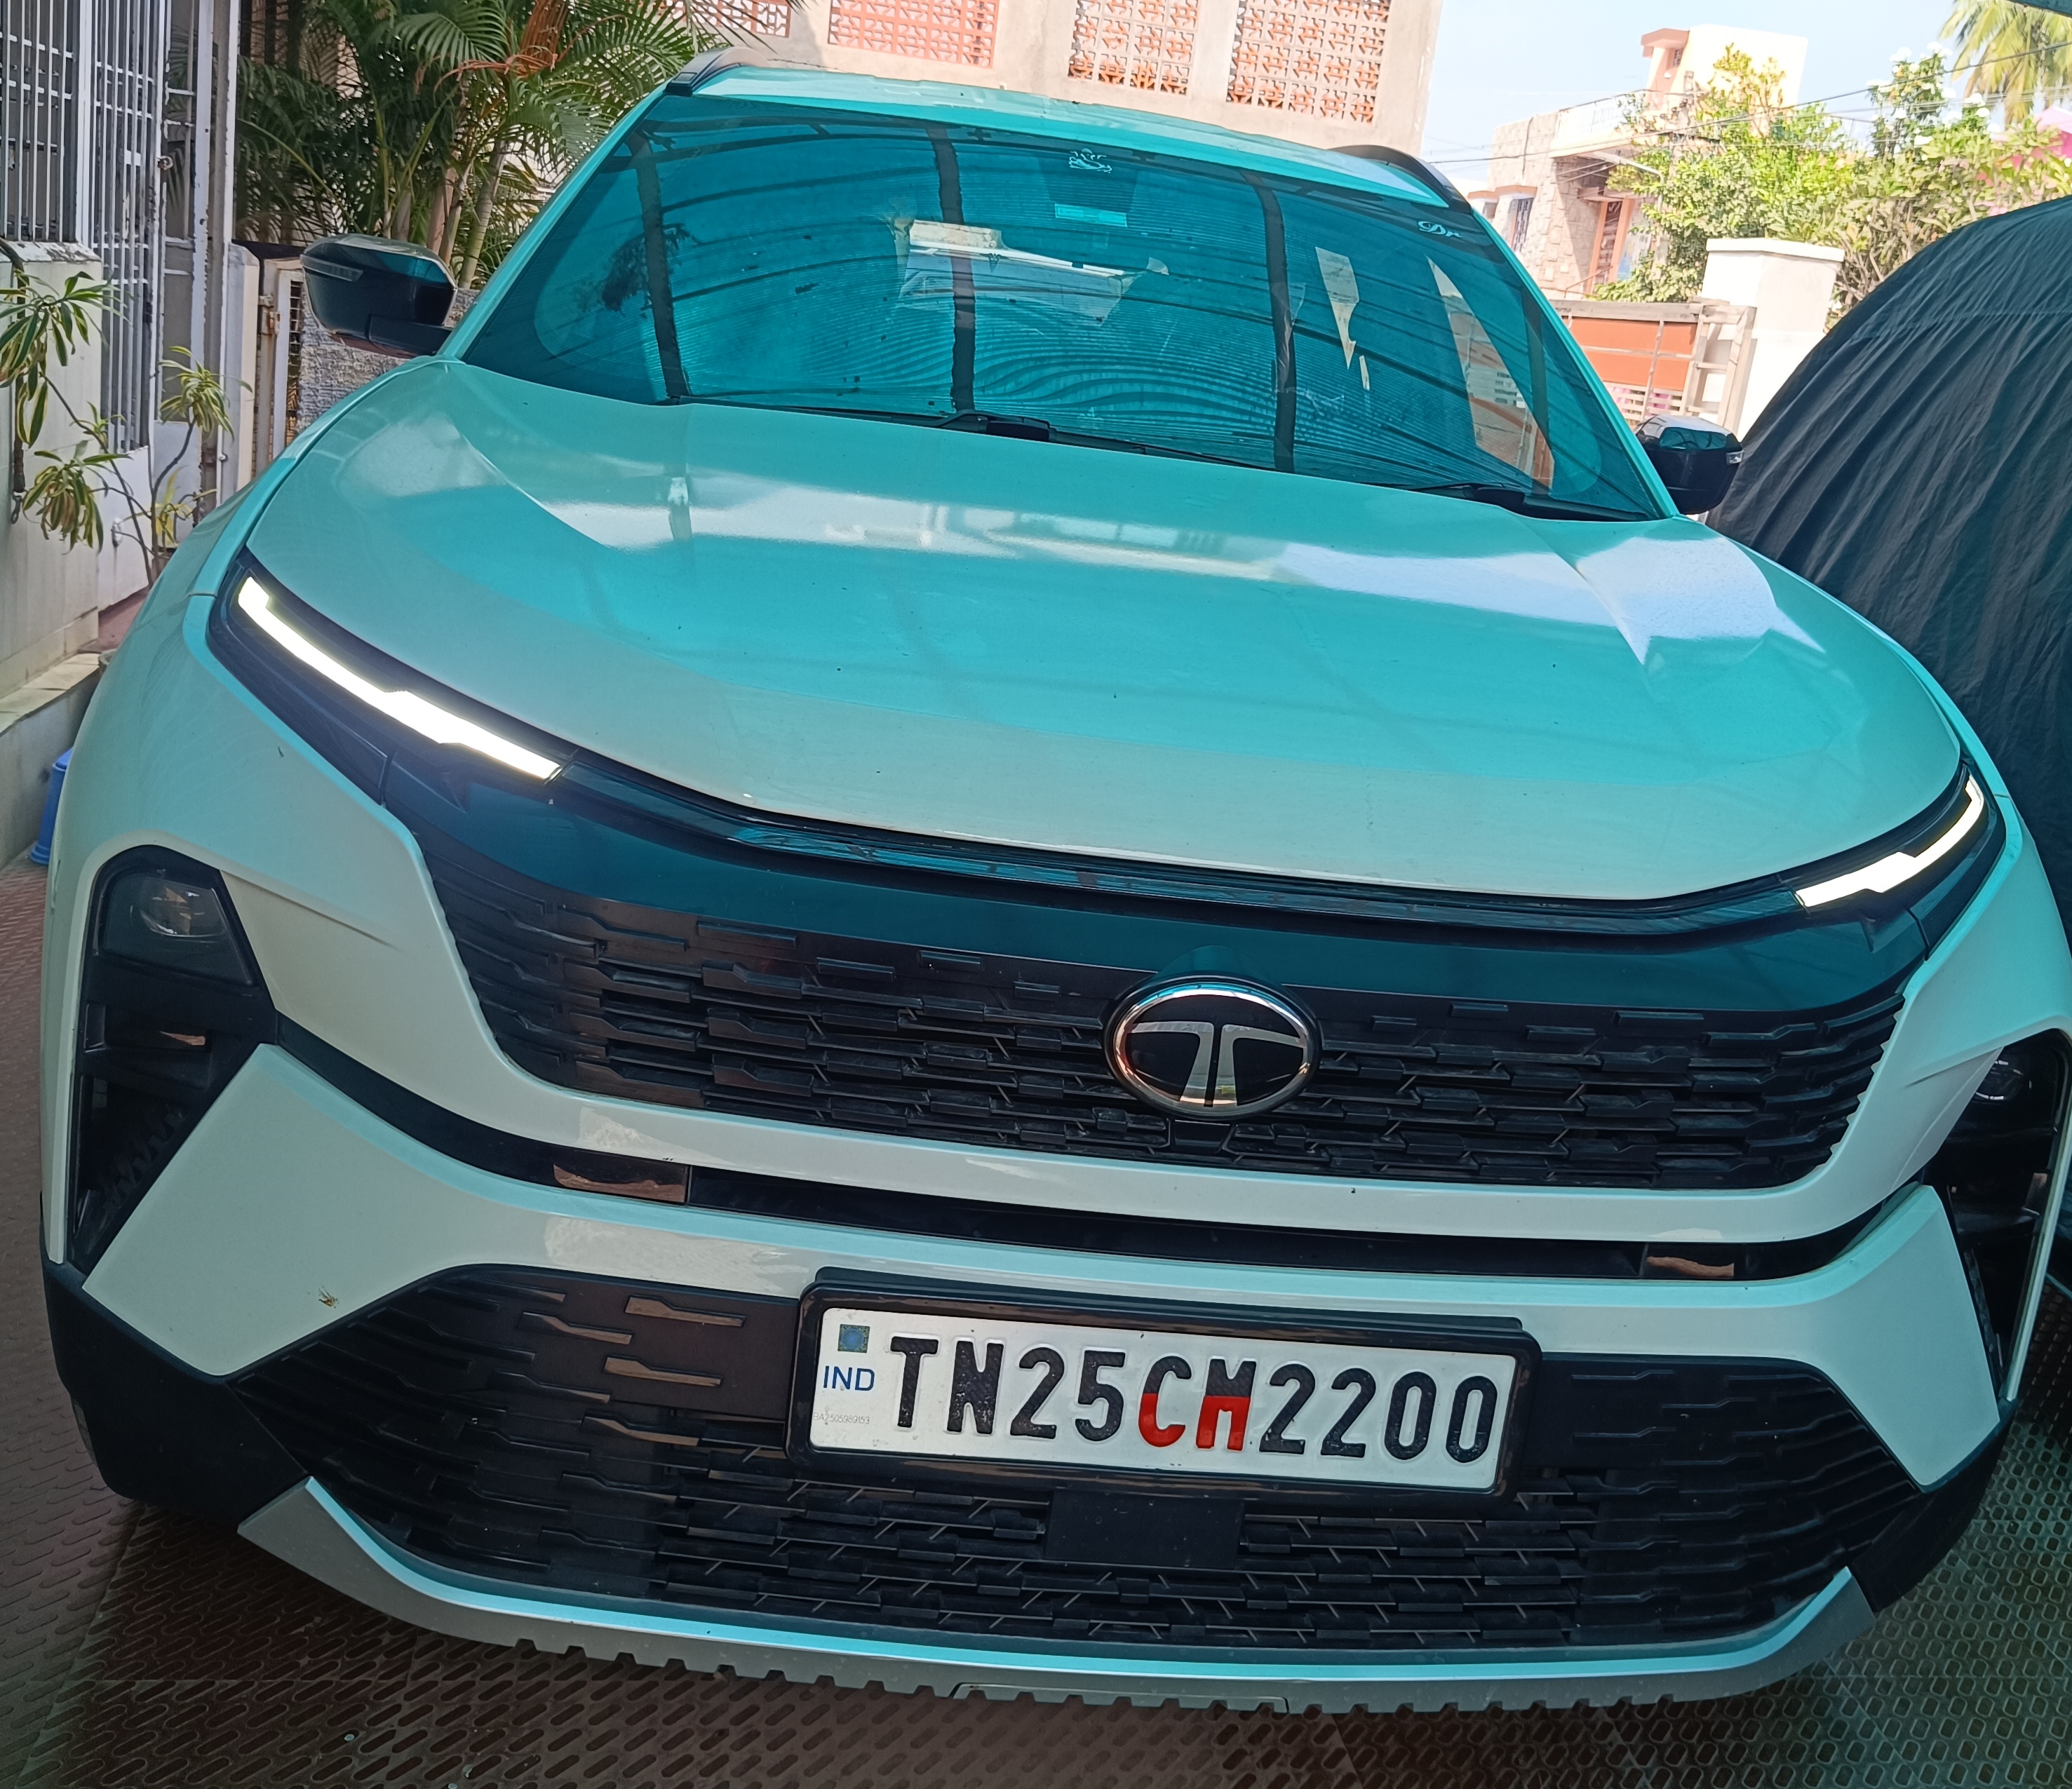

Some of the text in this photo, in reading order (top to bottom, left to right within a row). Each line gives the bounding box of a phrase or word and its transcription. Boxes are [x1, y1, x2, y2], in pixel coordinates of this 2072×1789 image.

[1418, 221, 1462, 238] Dr
[823, 1365, 875, 1391] IND
[889, 1336, 1498, 1464] TN25CM2200
